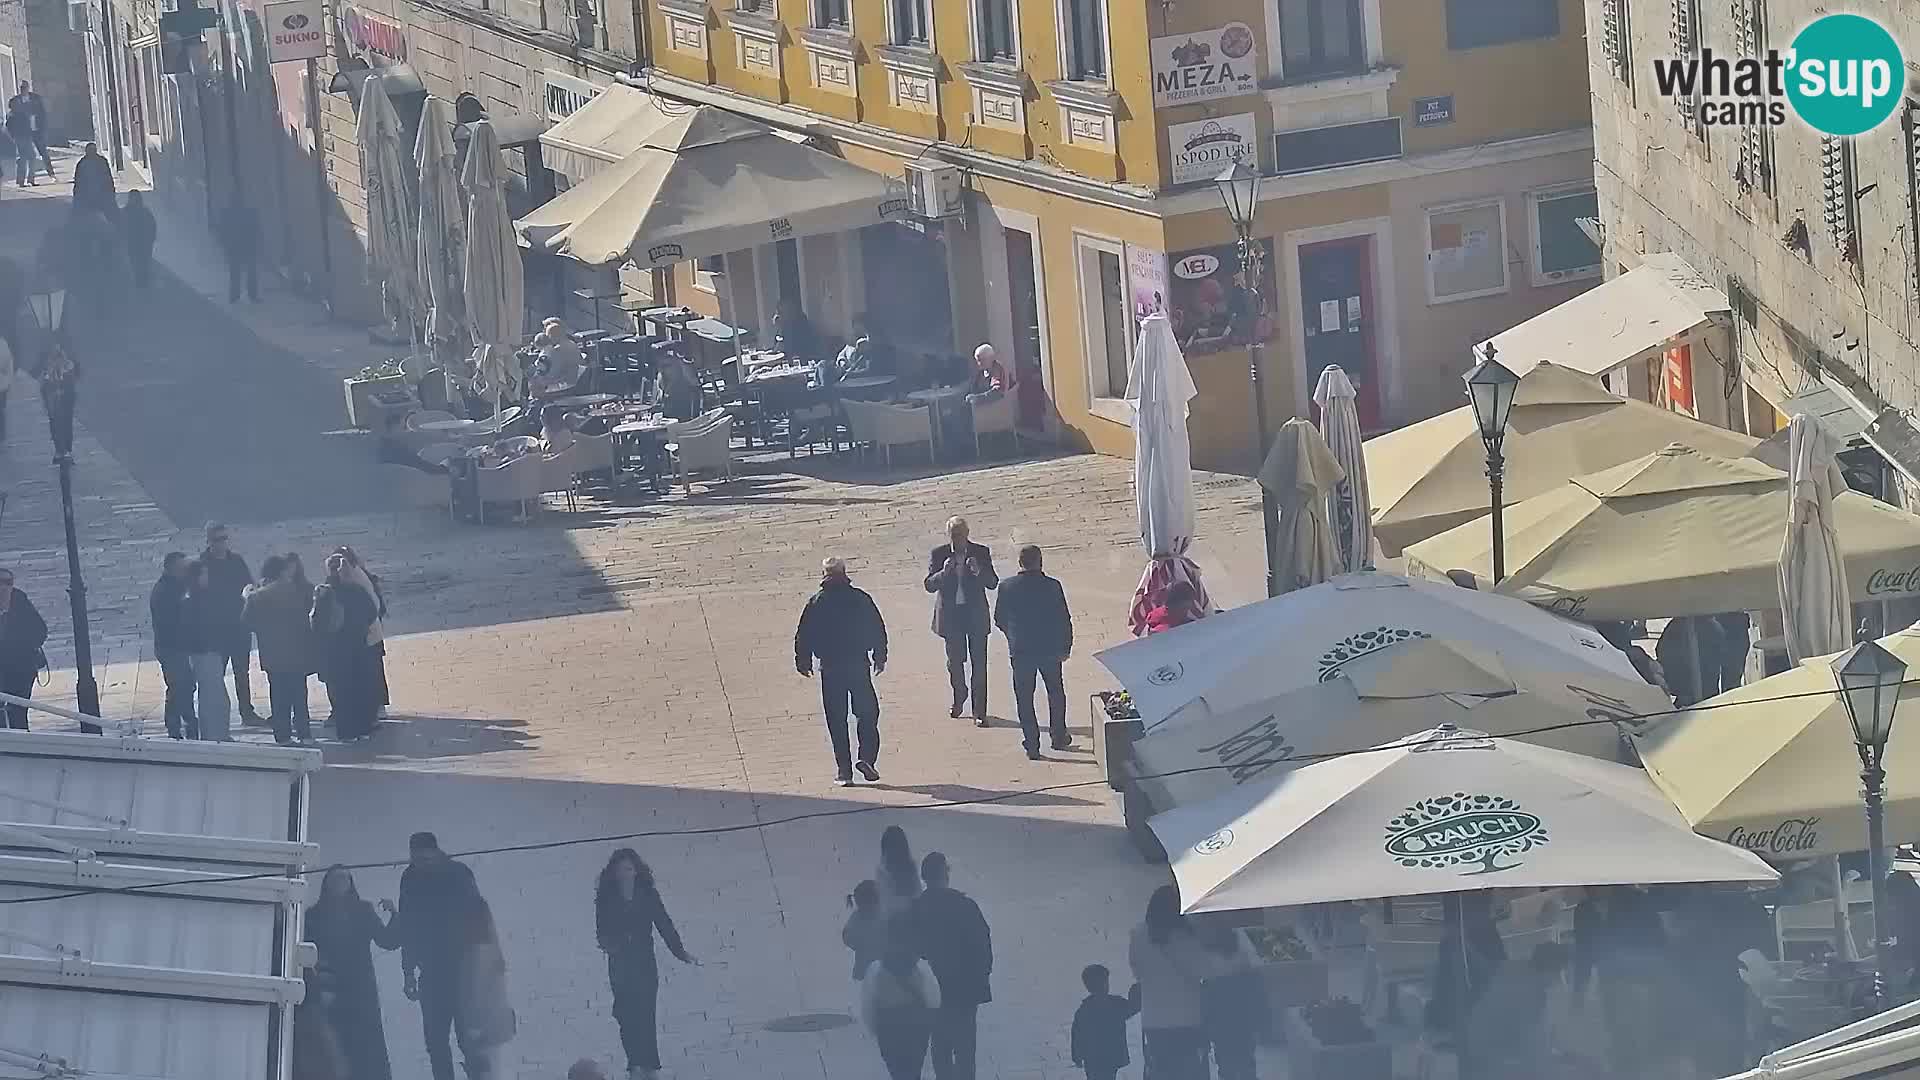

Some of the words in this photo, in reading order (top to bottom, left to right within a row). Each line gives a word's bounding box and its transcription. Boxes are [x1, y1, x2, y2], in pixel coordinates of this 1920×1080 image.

[275, 31, 320, 45] SUKNO
[1157, 62, 1236, 93] MEZA
[1176, 148, 1221, 166] ISPOD
[1225, 143, 1255, 159] URE
[1424, 815, 1523, 847] RAUCH
[1727, 816, 1820, 854] Coca-Cola
